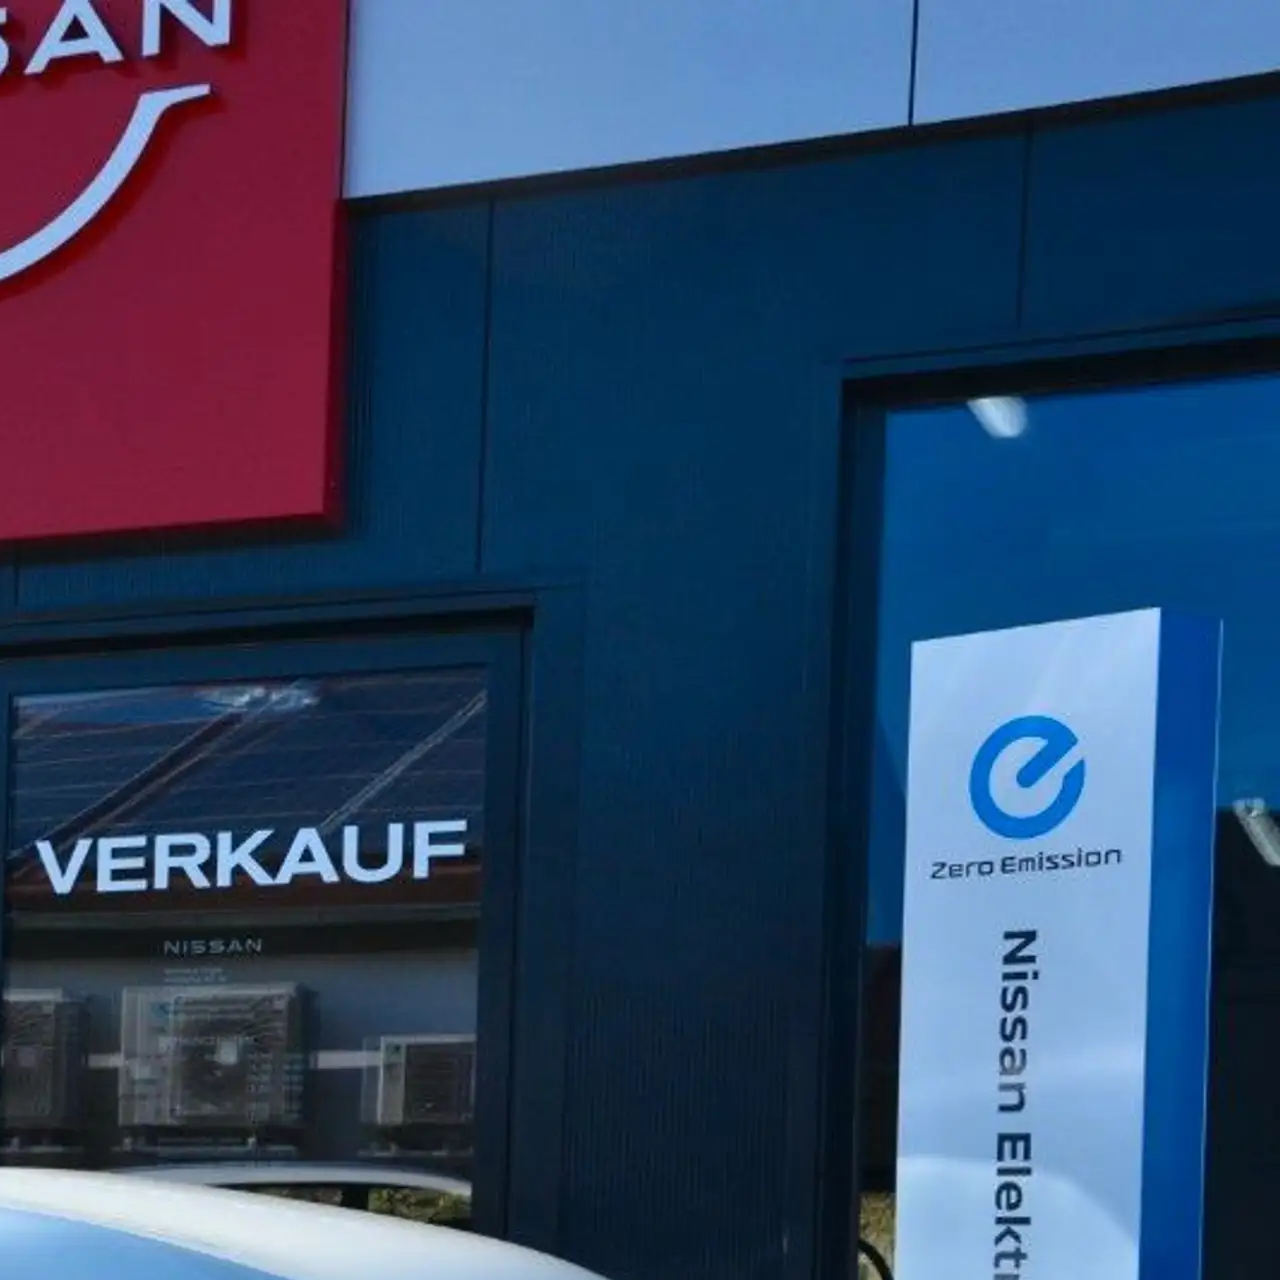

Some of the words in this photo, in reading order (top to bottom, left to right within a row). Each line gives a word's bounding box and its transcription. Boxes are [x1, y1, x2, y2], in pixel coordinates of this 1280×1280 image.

[36, 820, 466, 894] VERKAUF
[930, 861, 993, 880] Zero
[1001, 848, 1122, 875] Emission
[163, 938, 262, 955] NISSAN
[997, 929, 1040, 1114] Nissan
